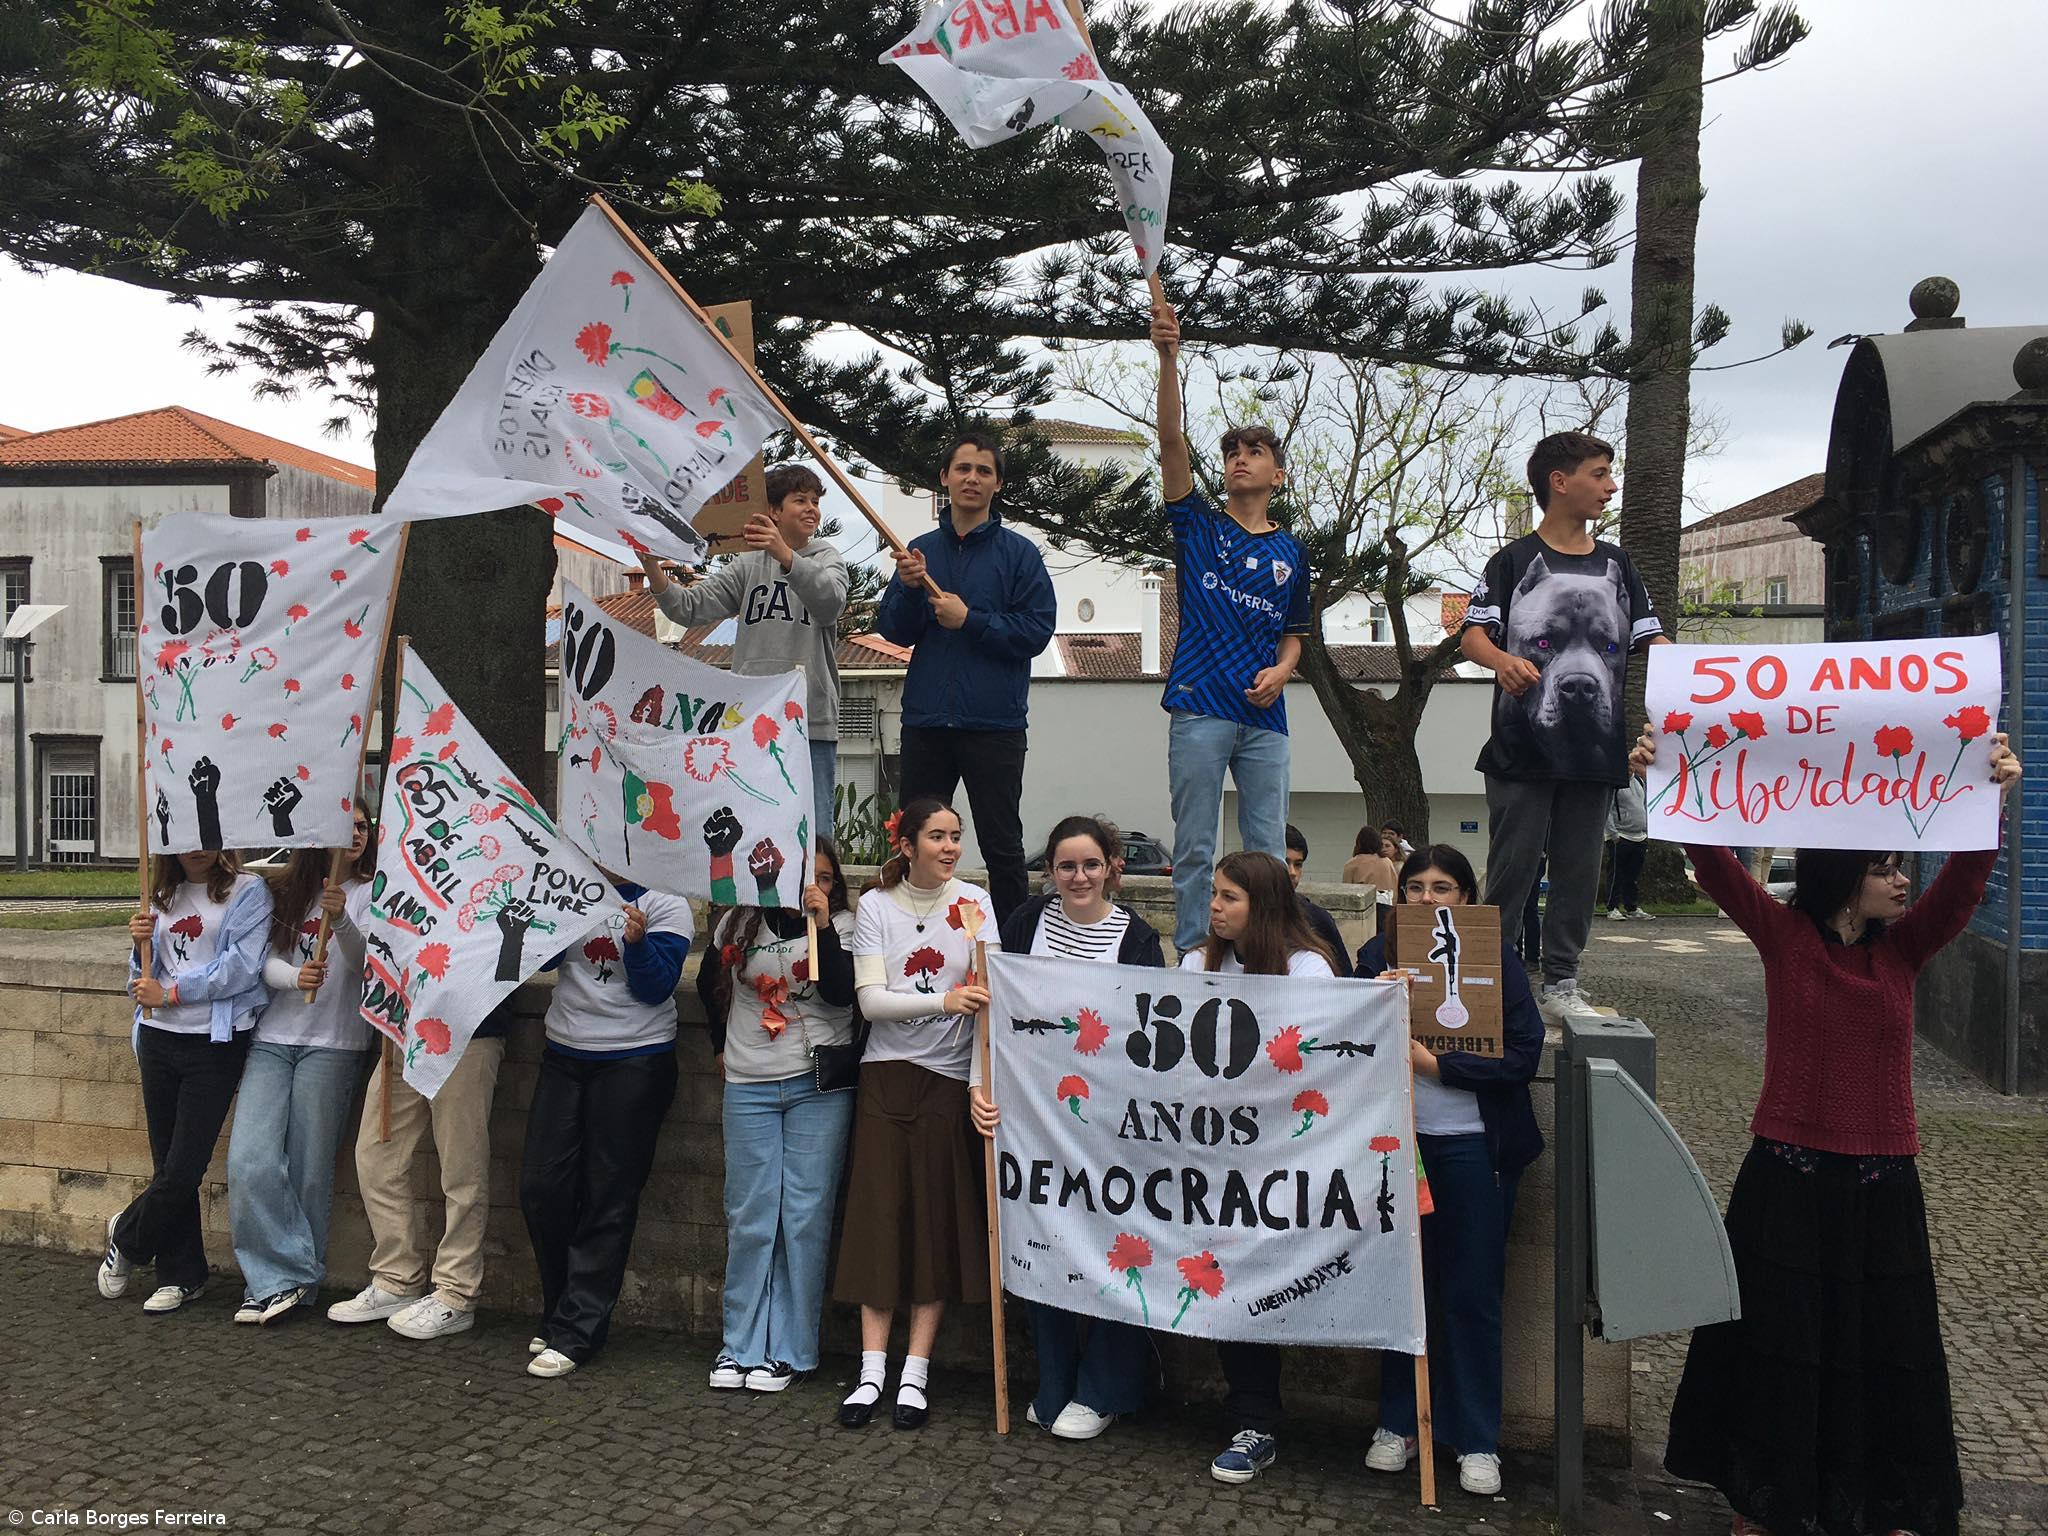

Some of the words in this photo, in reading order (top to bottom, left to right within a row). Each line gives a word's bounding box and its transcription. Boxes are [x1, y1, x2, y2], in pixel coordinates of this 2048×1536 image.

[161, 561, 269, 635] 50
[162, 654, 236, 676] ANOS
[563, 602, 615, 701] 50
[1689, 655, 1788, 704] 50
[1809, 651, 1969, 694] ANOS
[630, 684, 745, 735] ANOS
[1786, 705, 1840, 734] DE
[1663, 742, 1974, 824] Liberdade
[424, 817, 463, 851] DE
[406, 838, 462, 904] ABRIL
[532, 862, 605, 902] POVO
[382, 890, 438, 936] ANOS
[526, 885, 594, 916] LIVRE
[1125, 992, 1261, 1080] 50
[1411, 1035, 1494, 1052] LIBERDA
[1117, 1098, 1261, 1146] ANOS
[999, 1151, 1362, 1232] DEMOCRACIA
[1011, 1254, 1031, 1271] abril
[1027, 1239, 1051, 1251] amor
[1067, 1273, 1084, 1283] paz
